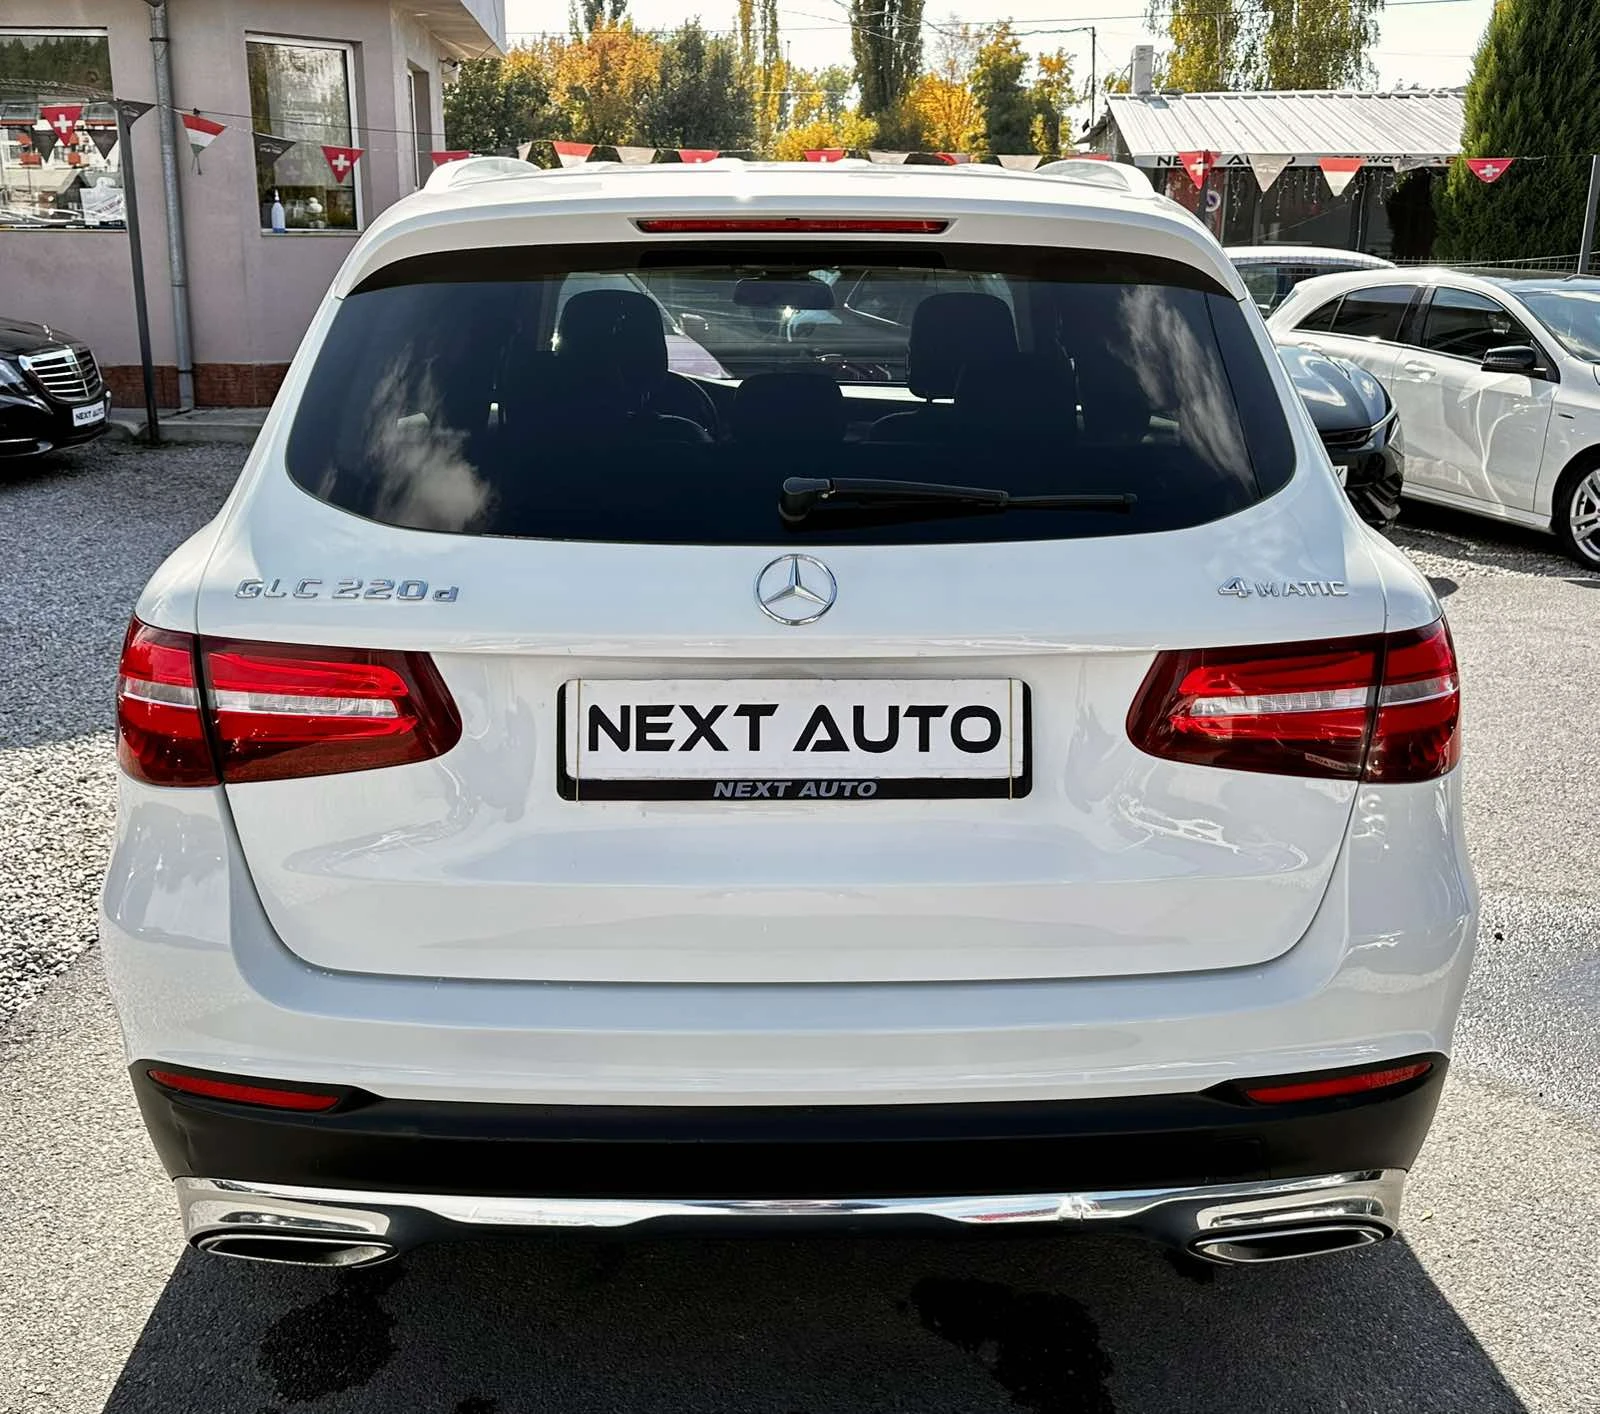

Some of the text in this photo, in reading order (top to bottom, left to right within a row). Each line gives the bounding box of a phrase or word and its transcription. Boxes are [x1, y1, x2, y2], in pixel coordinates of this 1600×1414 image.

[234, 578, 322, 599] GLC
[587, 703, 1003, 754] NEXT AUTO
[712, 781, 878, 798] NEXT AUTO
